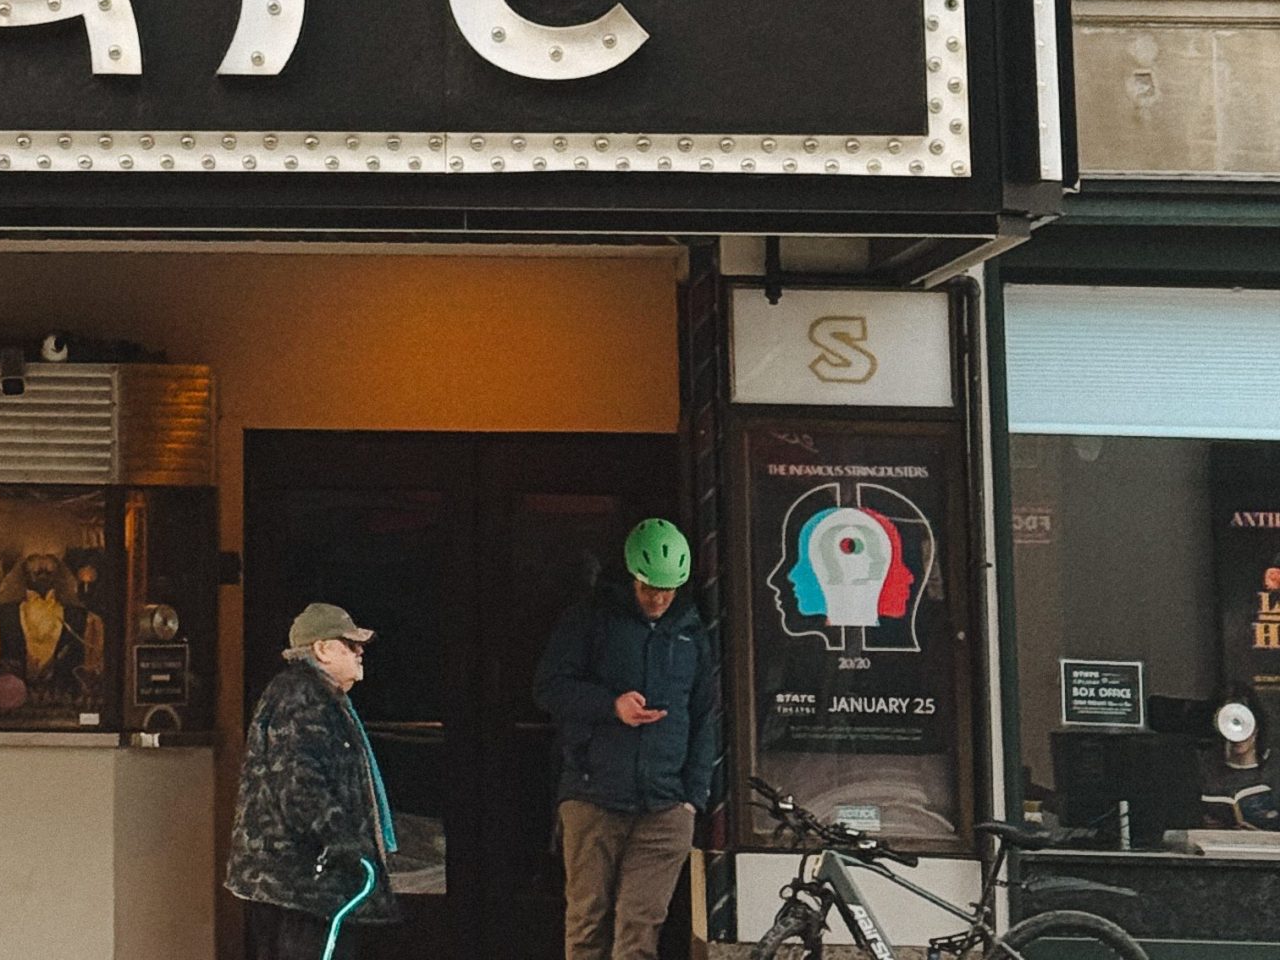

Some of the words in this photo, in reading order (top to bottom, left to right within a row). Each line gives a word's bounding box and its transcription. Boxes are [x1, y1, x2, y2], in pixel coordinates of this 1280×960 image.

[808, 315, 878, 384] S
[768, 464, 786, 476] THE
[789, 464, 844, 477] INFAMOUS
[776, 694, 816, 703] STATE
[1072, 687, 1096, 697] BOX
[1099, 687, 1132, 699] OFFICE
[828, 696, 910, 714] JANUARY
[913, 697, 936, 715] 25
